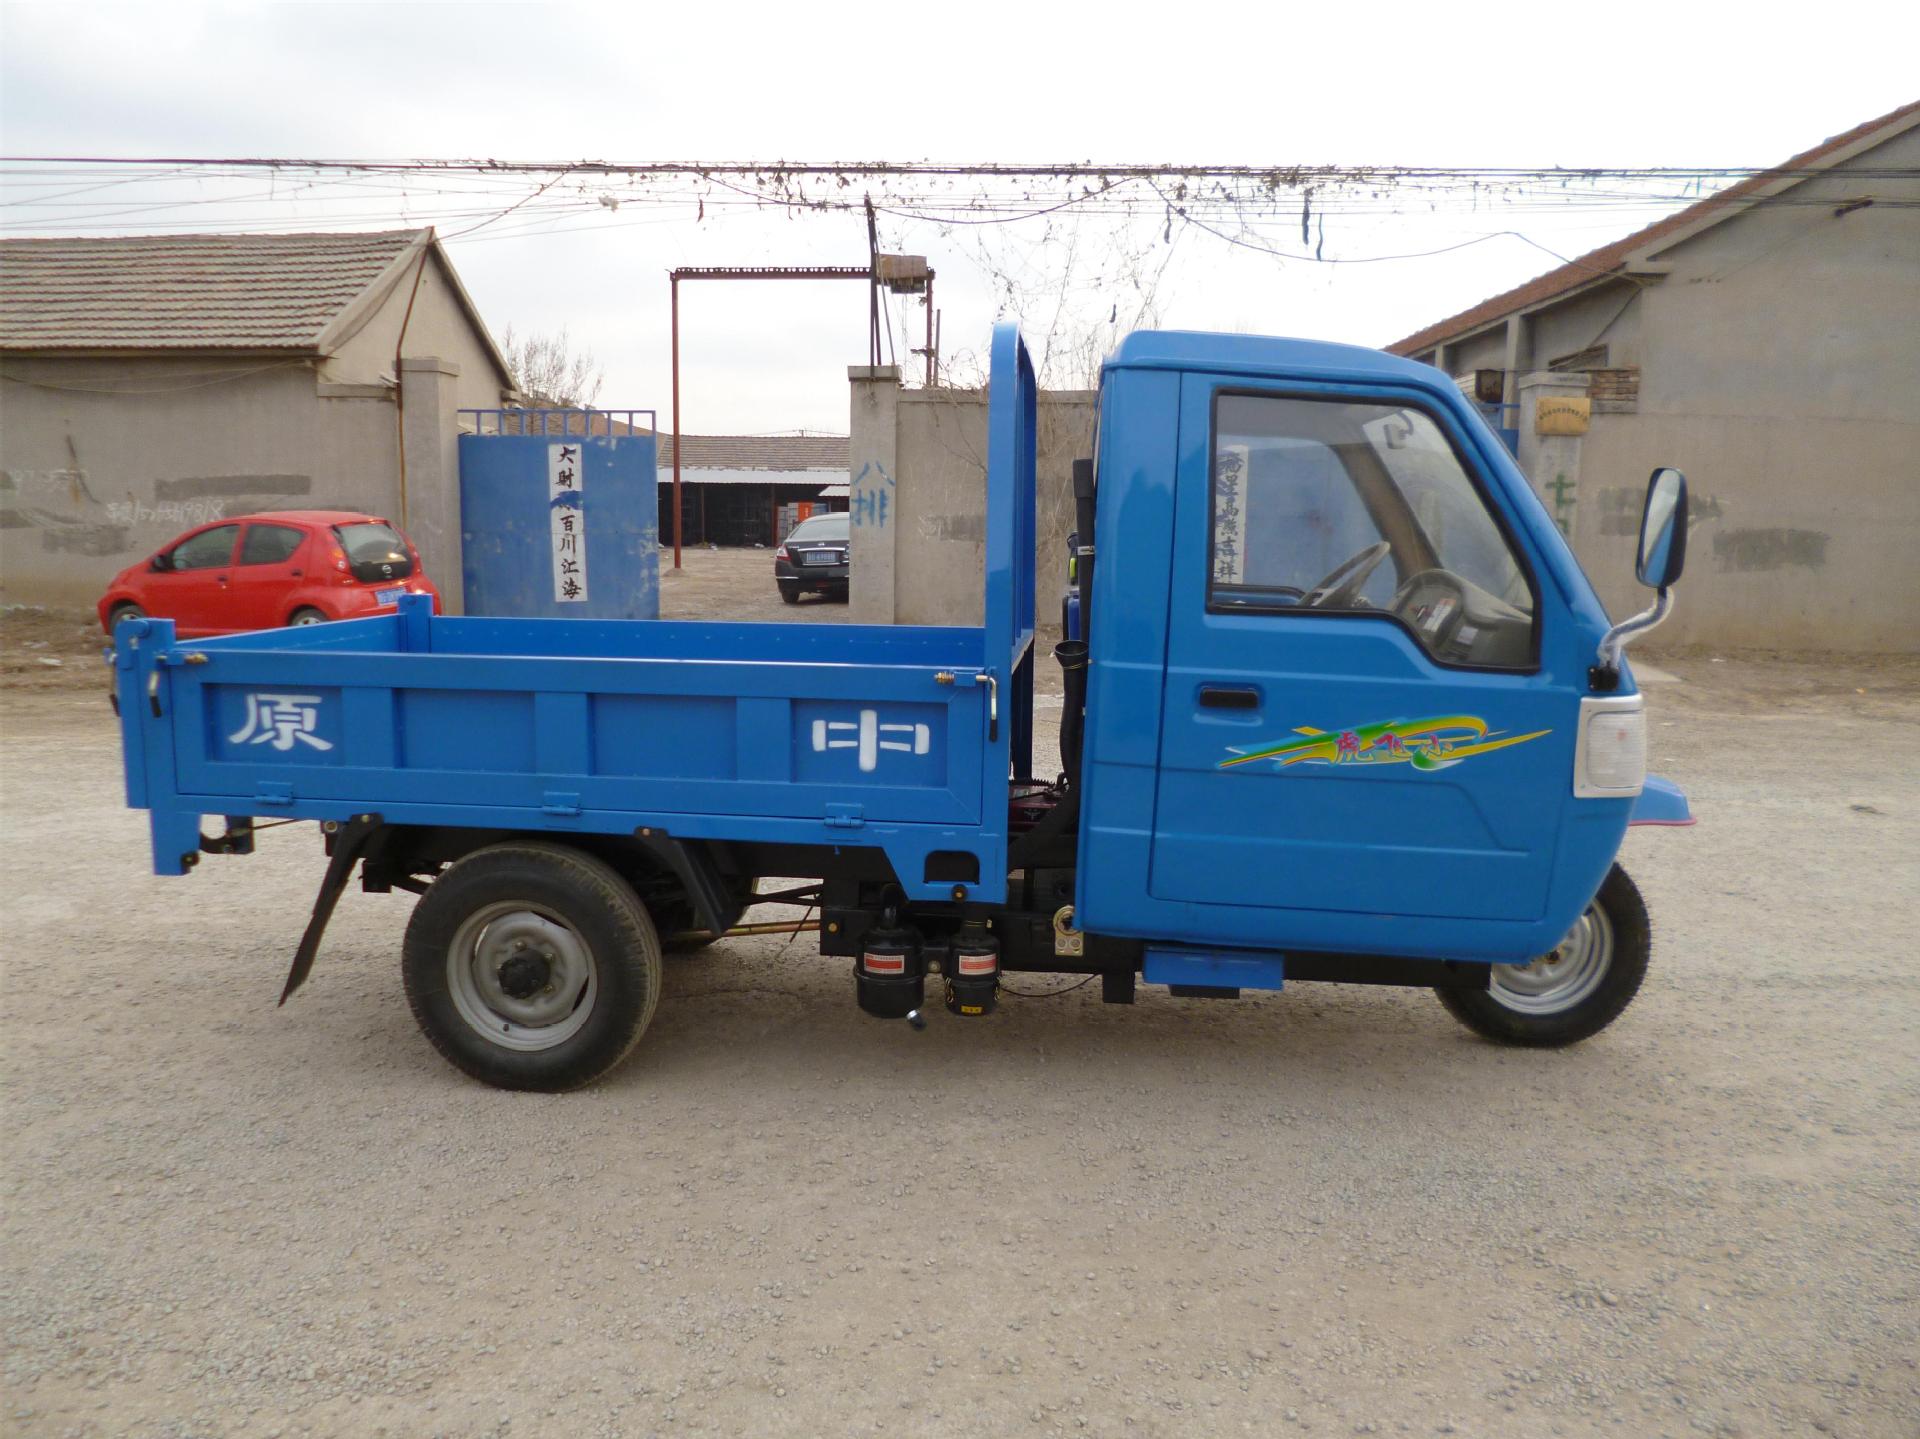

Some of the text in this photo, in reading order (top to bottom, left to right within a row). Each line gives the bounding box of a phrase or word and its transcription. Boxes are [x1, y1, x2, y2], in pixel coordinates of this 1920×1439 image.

[555, 446, 583, 600] 大财百川汇海
[229, 694, 334, 751] 原
[812, 709, 930, 772] 中
